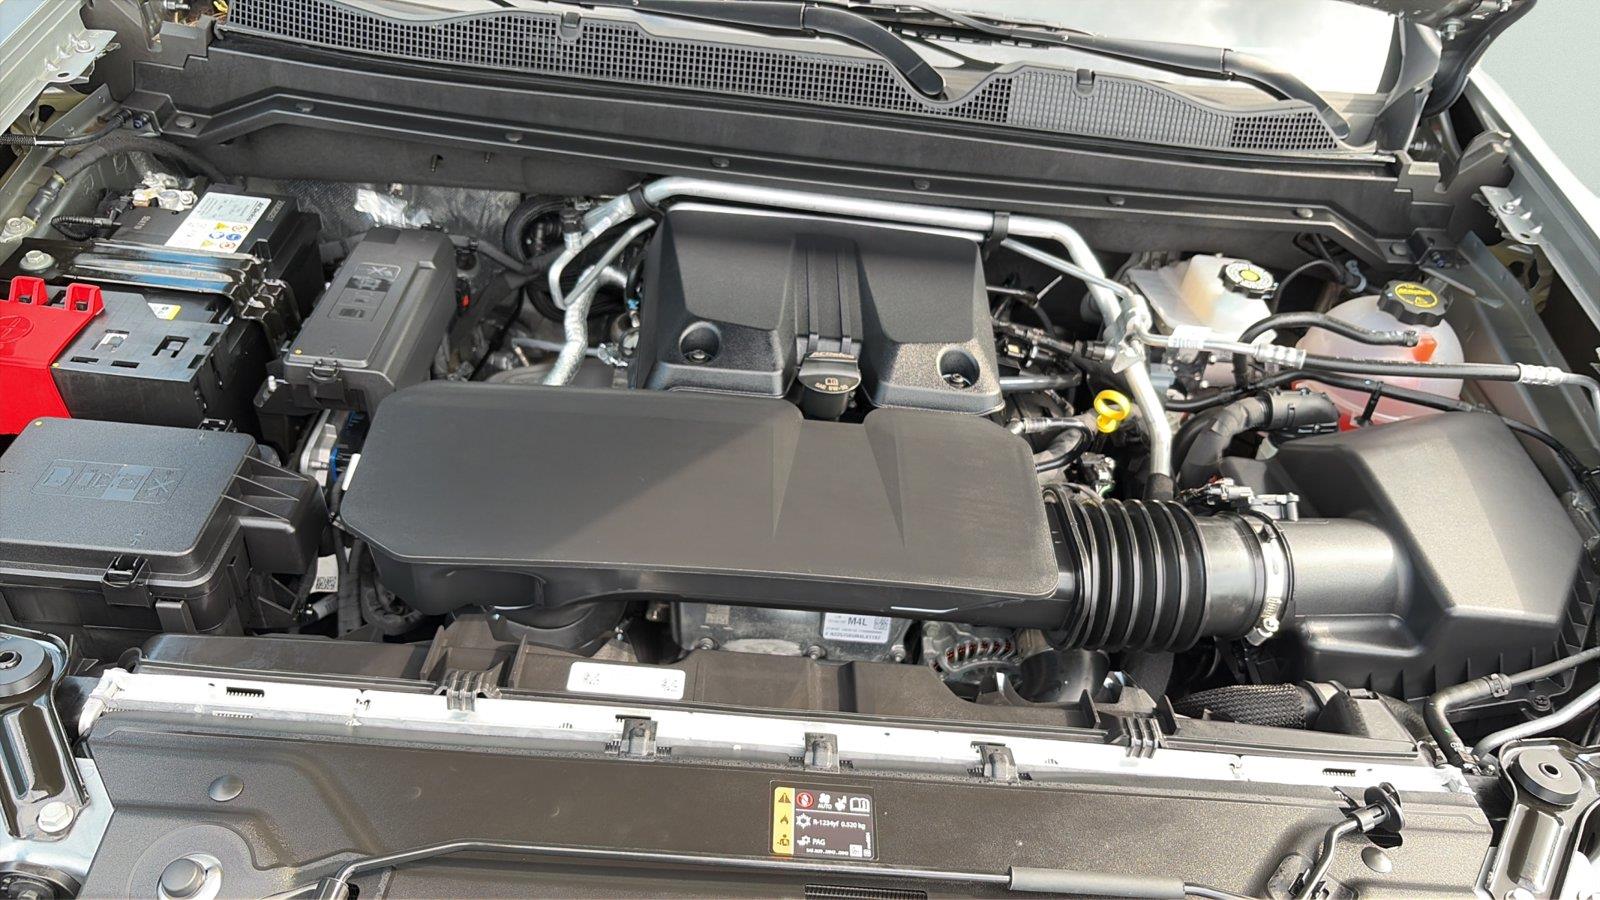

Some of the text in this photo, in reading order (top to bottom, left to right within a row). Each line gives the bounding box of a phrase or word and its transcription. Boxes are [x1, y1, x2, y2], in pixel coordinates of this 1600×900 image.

[848, 616, 868, 627] M4L
[812, 818, 840, 829] R-1234yf
[858, 822, 866, 830] kg
[812, 838, 826, 846] PAG
